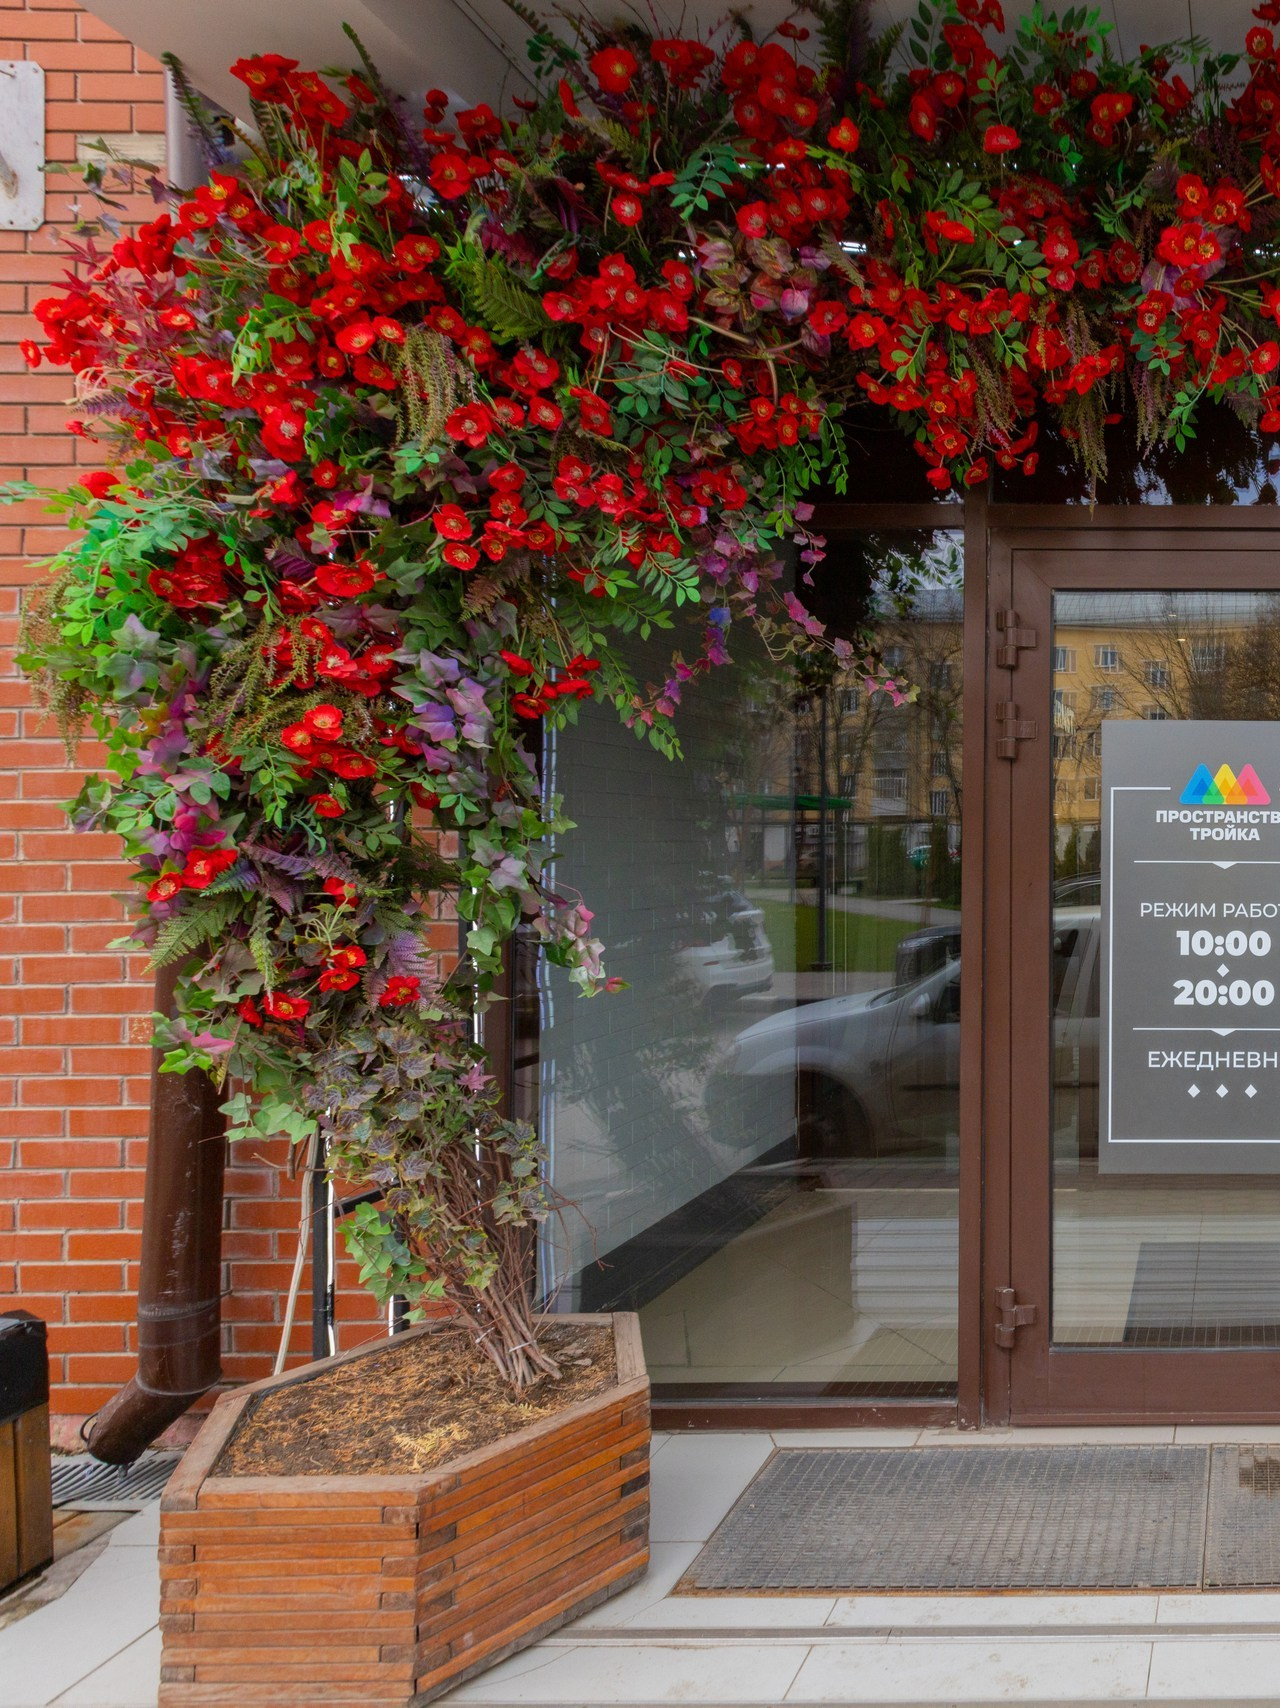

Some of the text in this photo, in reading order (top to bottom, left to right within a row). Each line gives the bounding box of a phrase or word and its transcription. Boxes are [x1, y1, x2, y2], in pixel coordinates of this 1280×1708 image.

[1189, 824, 1261, 842] ТРОЙКА
[1140, 903, 1216, 918] РЕЖИМ
[1176, 930, 1272, 957] 10:00
[1173, 980, 1275, 1006] 20:00
